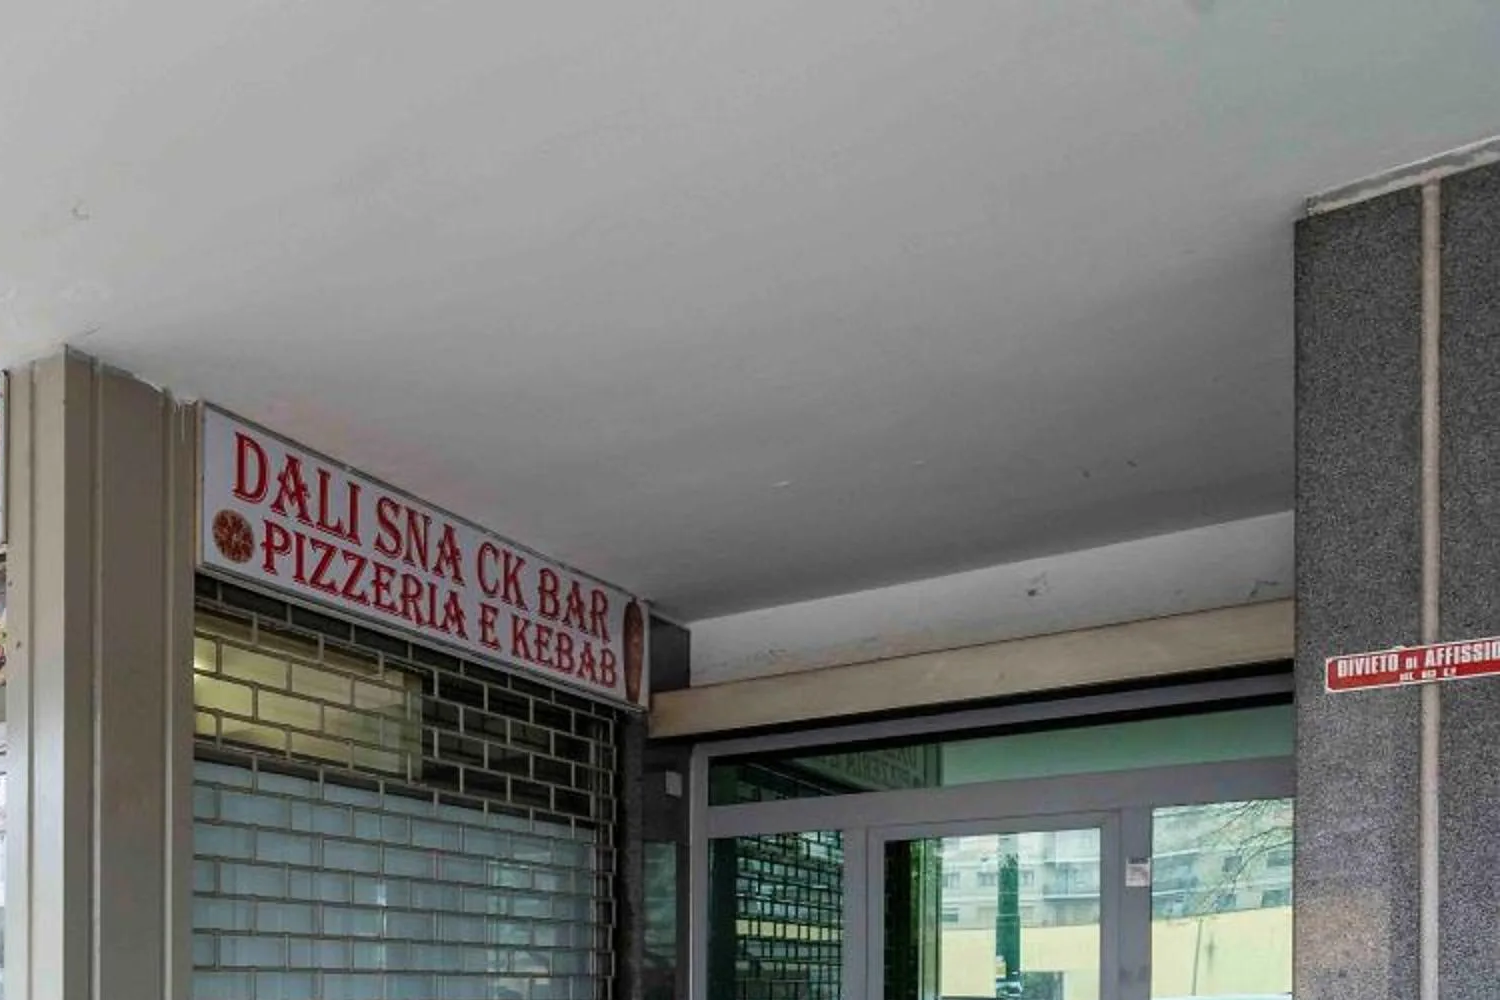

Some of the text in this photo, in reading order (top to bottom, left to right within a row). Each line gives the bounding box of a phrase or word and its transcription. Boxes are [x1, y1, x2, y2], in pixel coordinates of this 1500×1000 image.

[232, 431, 363, 546] DALI
[537, 566, 612, 643] BAR
[260, 518, 618, 690] PIZZERIA E KEBAB
[1336, 653, 1399, 679] DIVIETO
